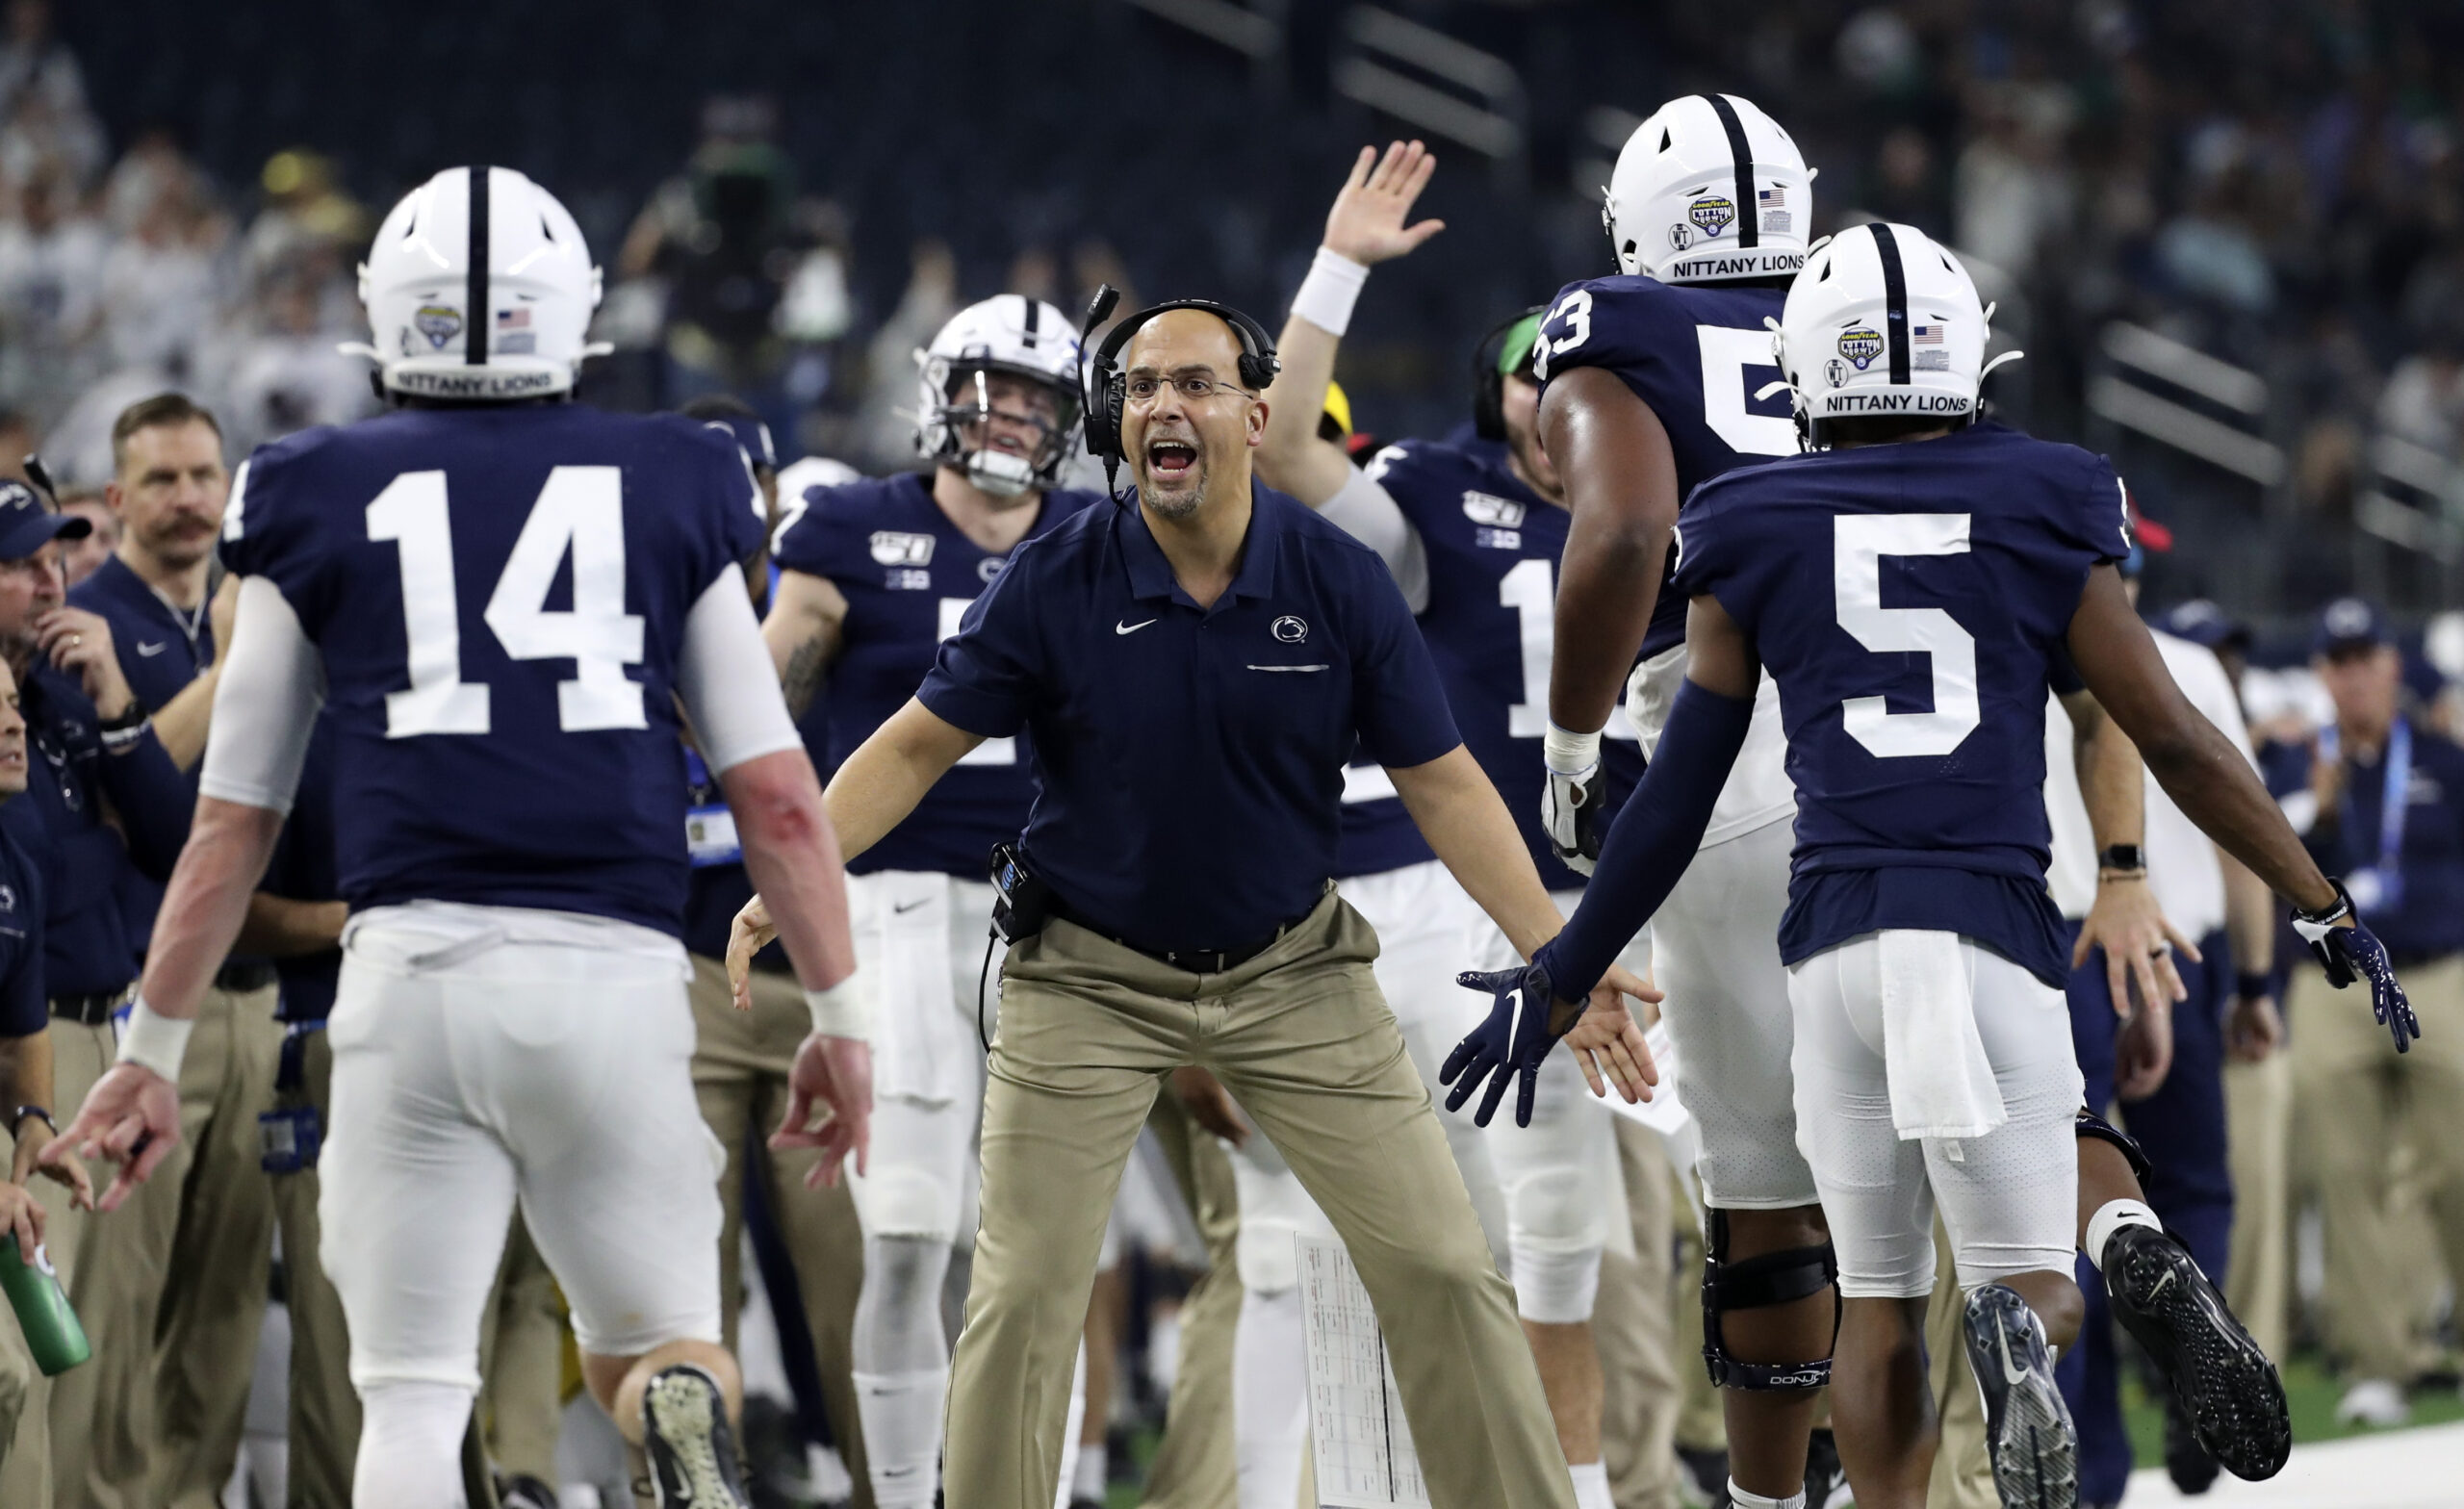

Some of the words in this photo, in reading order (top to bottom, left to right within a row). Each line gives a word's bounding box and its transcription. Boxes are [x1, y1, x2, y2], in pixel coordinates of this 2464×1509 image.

[1692, 207, 1732, 222] COTTON
[1673, 230, 1687, 244] WT
[1674, 257, 1758, 278] NITTANY
[1762, 254, 1805, 271] LIONS
[1841, 339, 1881, 353] COTTON
[1828, 367, 1843, 381] WT
[1827, 395, 1912, 412] NITTANY
[1918, 396, 1968, 411] LIONS
[365, 466, 650, 739] 14
[1834, 513, 1980, 757] 5
